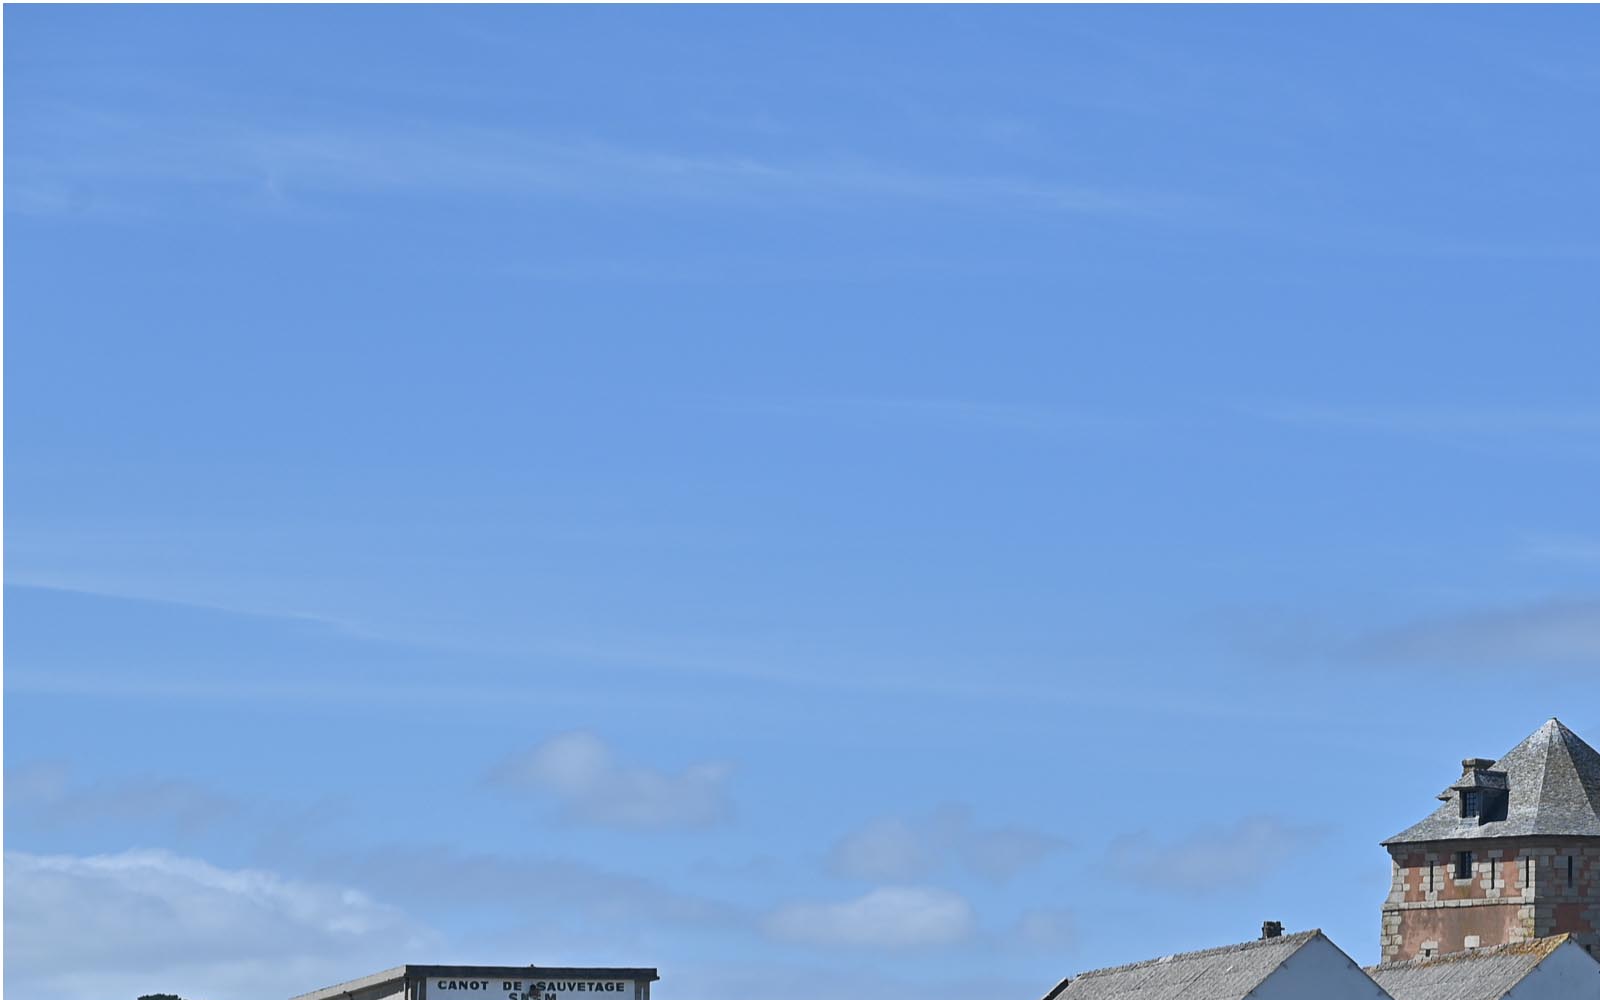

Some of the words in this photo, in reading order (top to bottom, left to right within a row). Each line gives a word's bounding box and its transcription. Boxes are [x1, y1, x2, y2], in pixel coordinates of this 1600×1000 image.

[437, 980, 489, 991] CANOT
[502, 980, 522, 991] DE
[536, 980, 625, 992] SAUVETAGE
